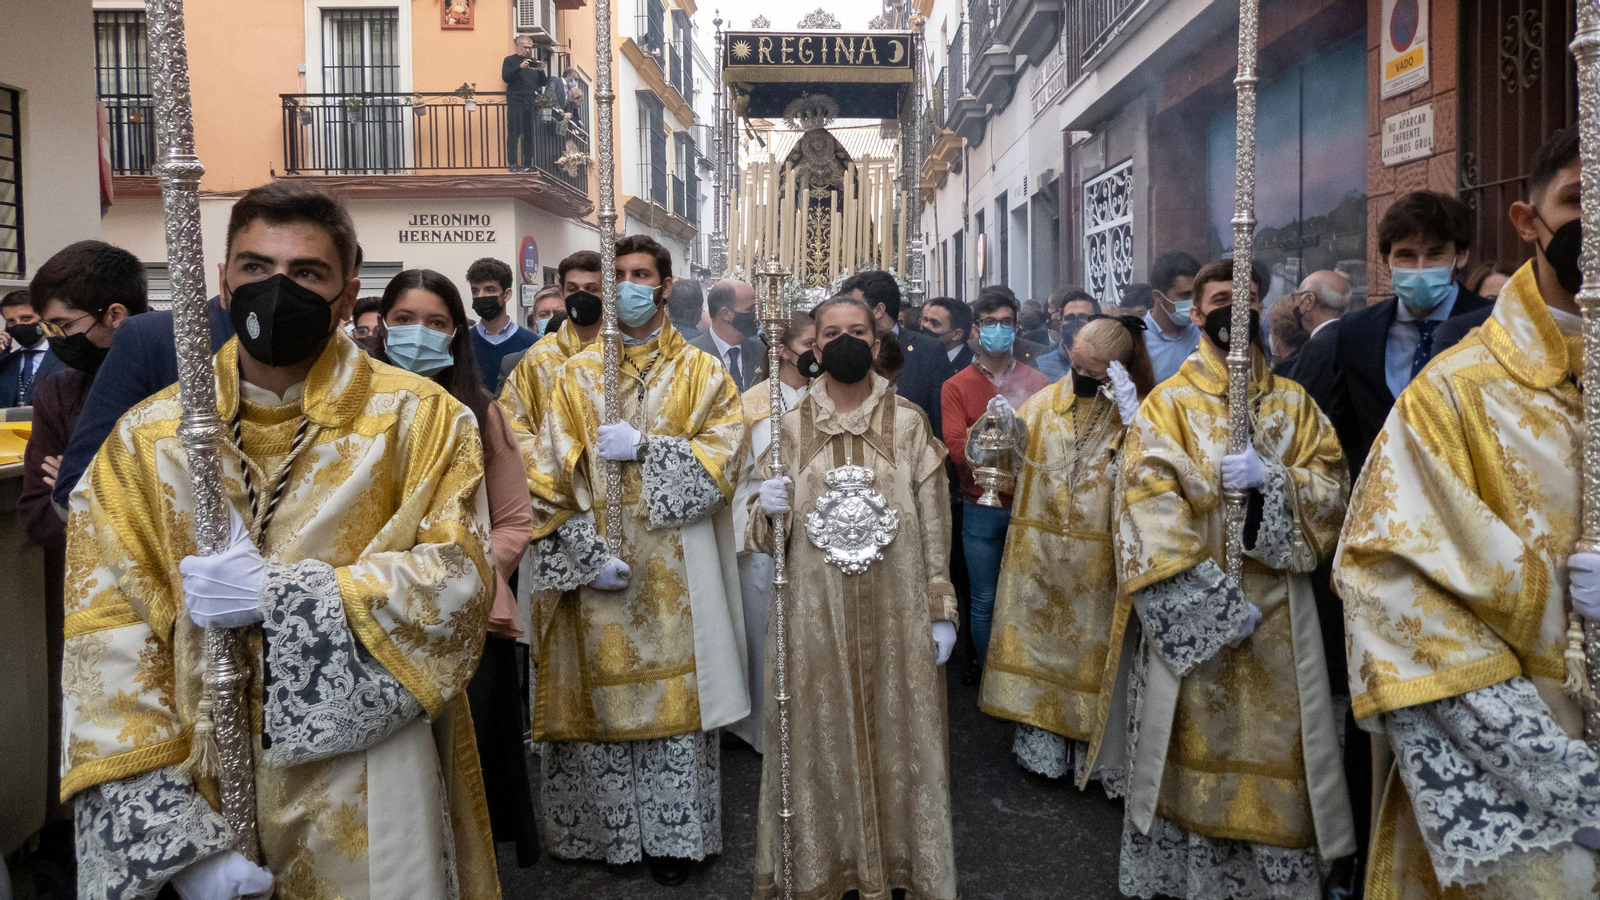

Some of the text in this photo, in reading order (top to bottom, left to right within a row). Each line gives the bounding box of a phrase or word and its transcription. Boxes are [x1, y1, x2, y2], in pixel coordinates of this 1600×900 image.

[758, 36, 880, 65] REGINA
[1395, 56, 1414, 72] VADO
[1388, 112, 1427, 133] NO APARCAR
[1392, 127, 1421, 144] ENFRENTE
[1383, 136, 1432, 158] AVISAMOS GRUA
[408, 213, 491, 227] JERONIMO
[398, 229, 496, 242] HERNANDEZ
